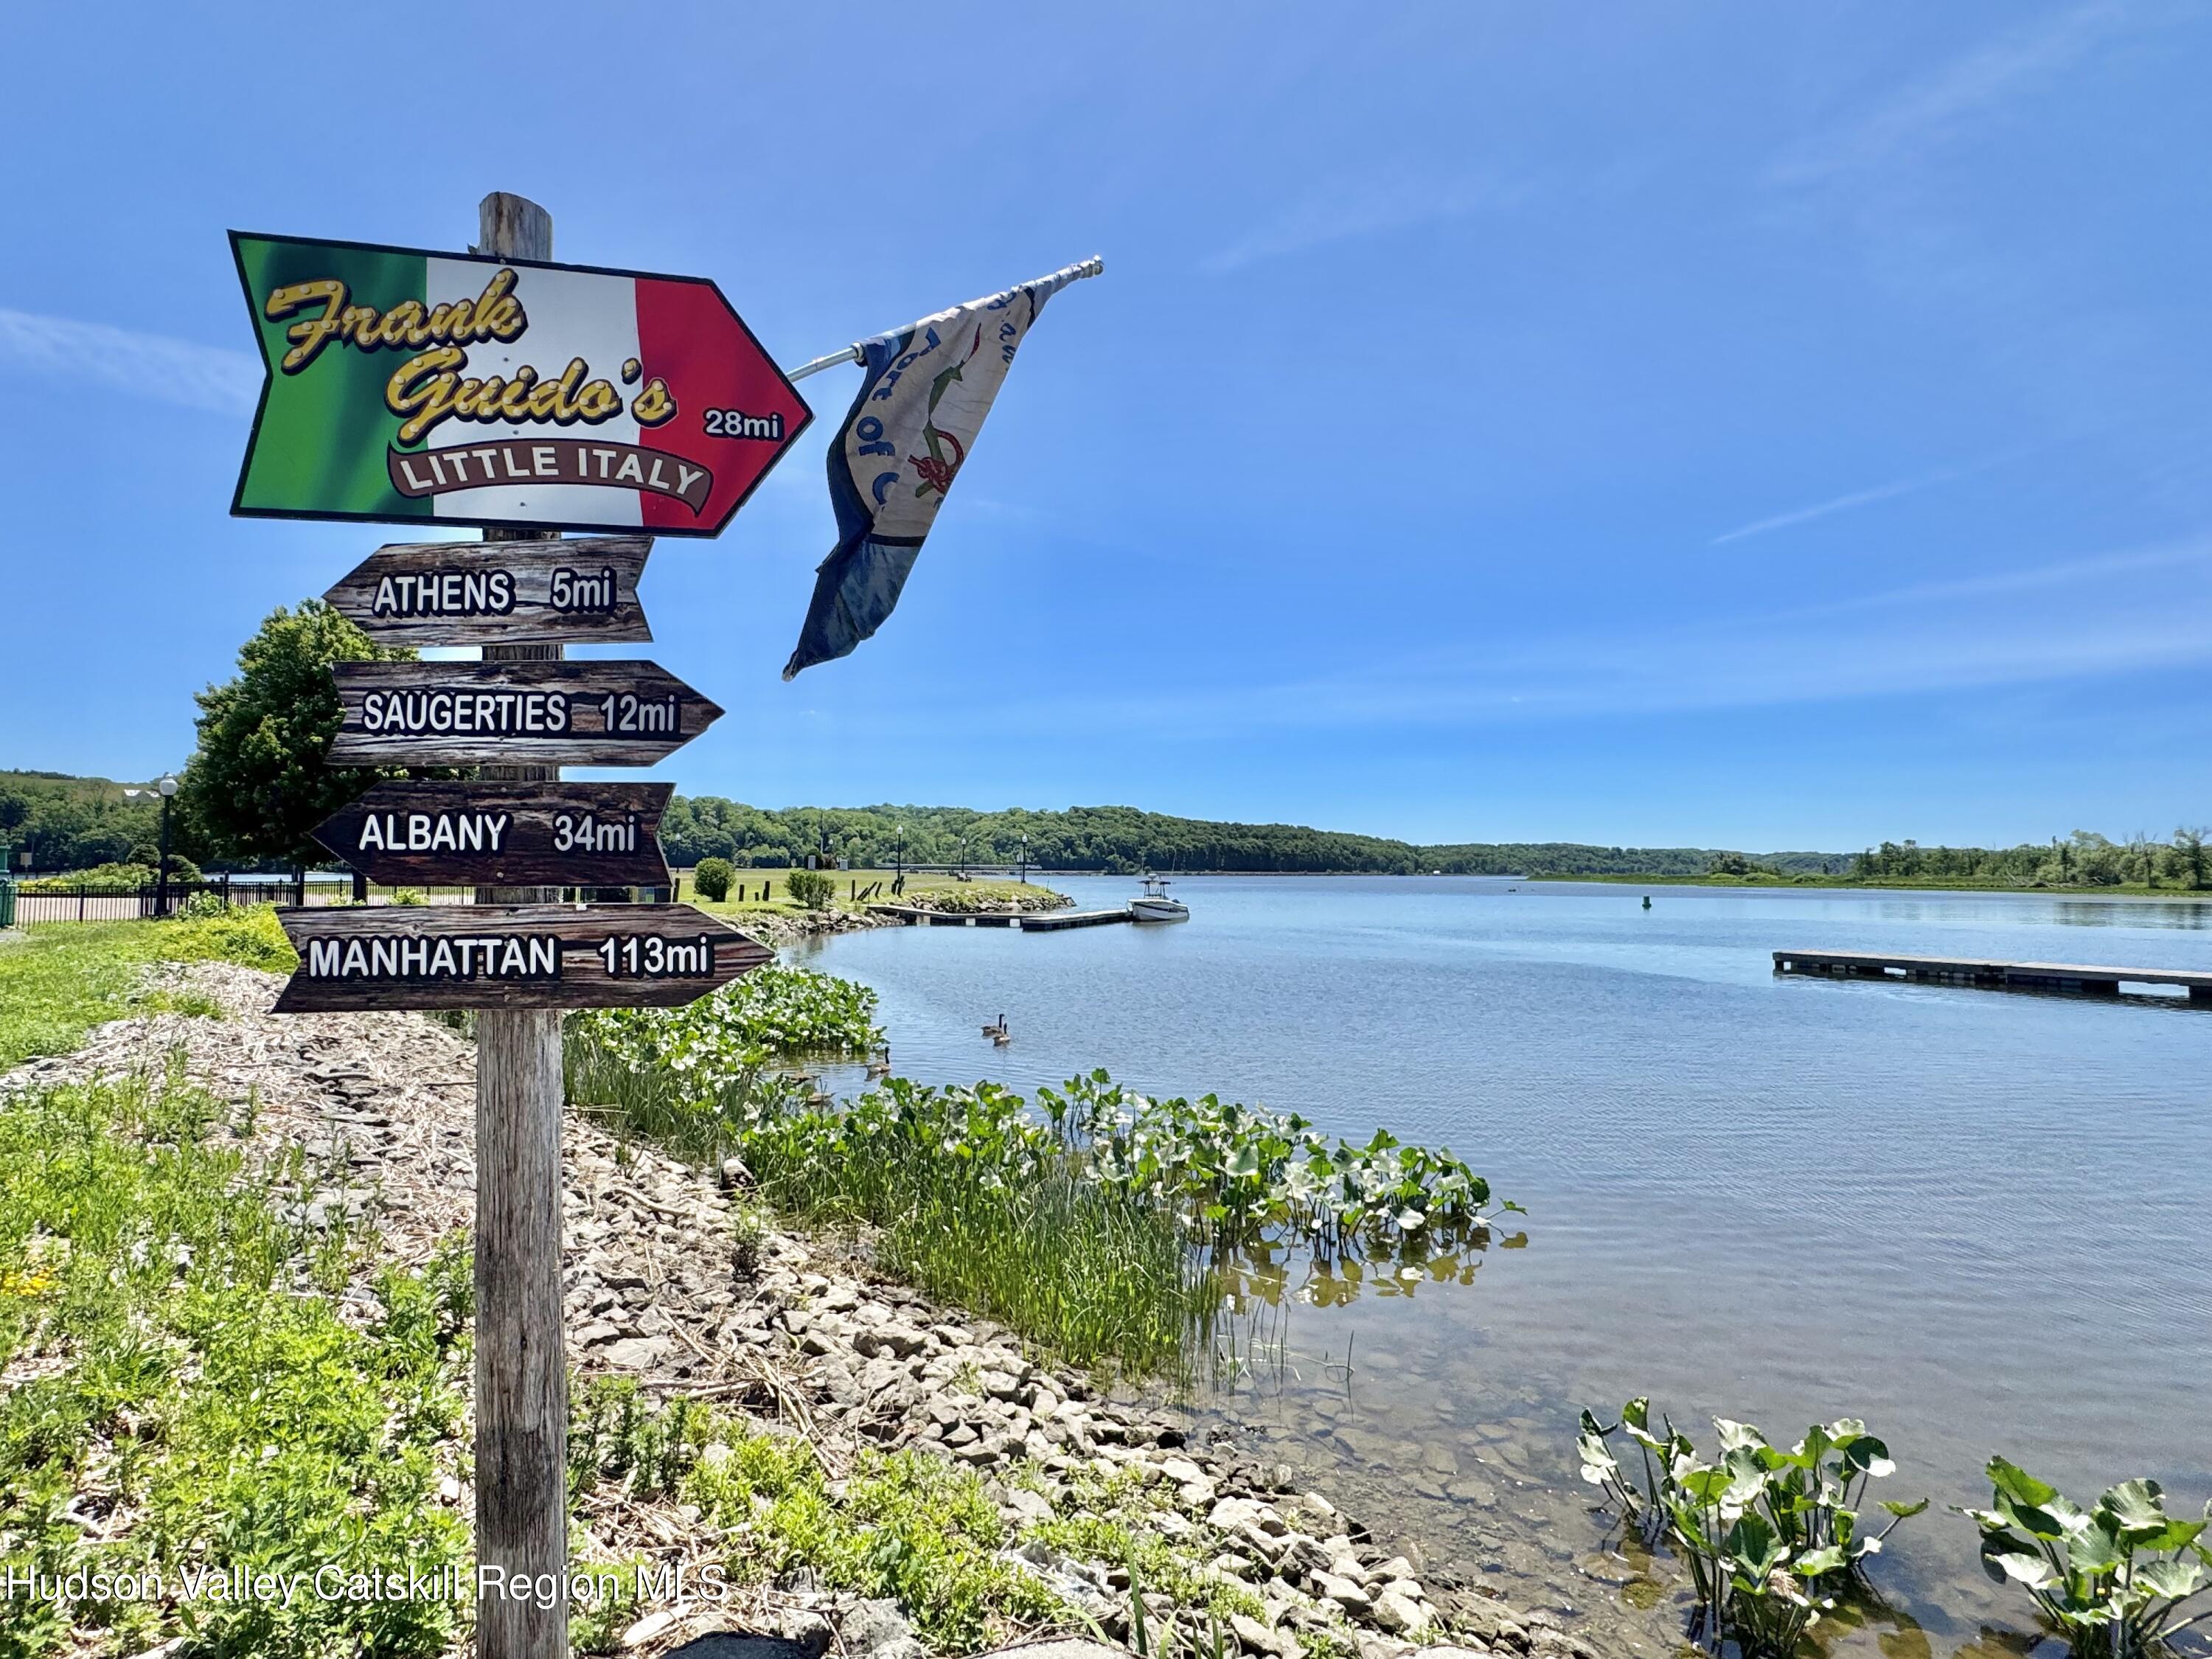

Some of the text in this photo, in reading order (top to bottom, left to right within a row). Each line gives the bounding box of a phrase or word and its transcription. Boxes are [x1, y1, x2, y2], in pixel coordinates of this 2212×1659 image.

[265, 268, 528, 373] Frank
[385, 346, 677, 442] Guido's
[705, 410, 779, 438] 28mi
[857, 416, 896, 456] of
[400, 446, 706, 495] LITTLE ITALY
[373, 570, 611, 612] ATHENS 5mi
[364, 694, 676, 731] SAUGERTIES 12mi
[358, 813, 636, 852] ALBANY 34mi
[308, 936, 708, 977] MANHATTAN 113mi
